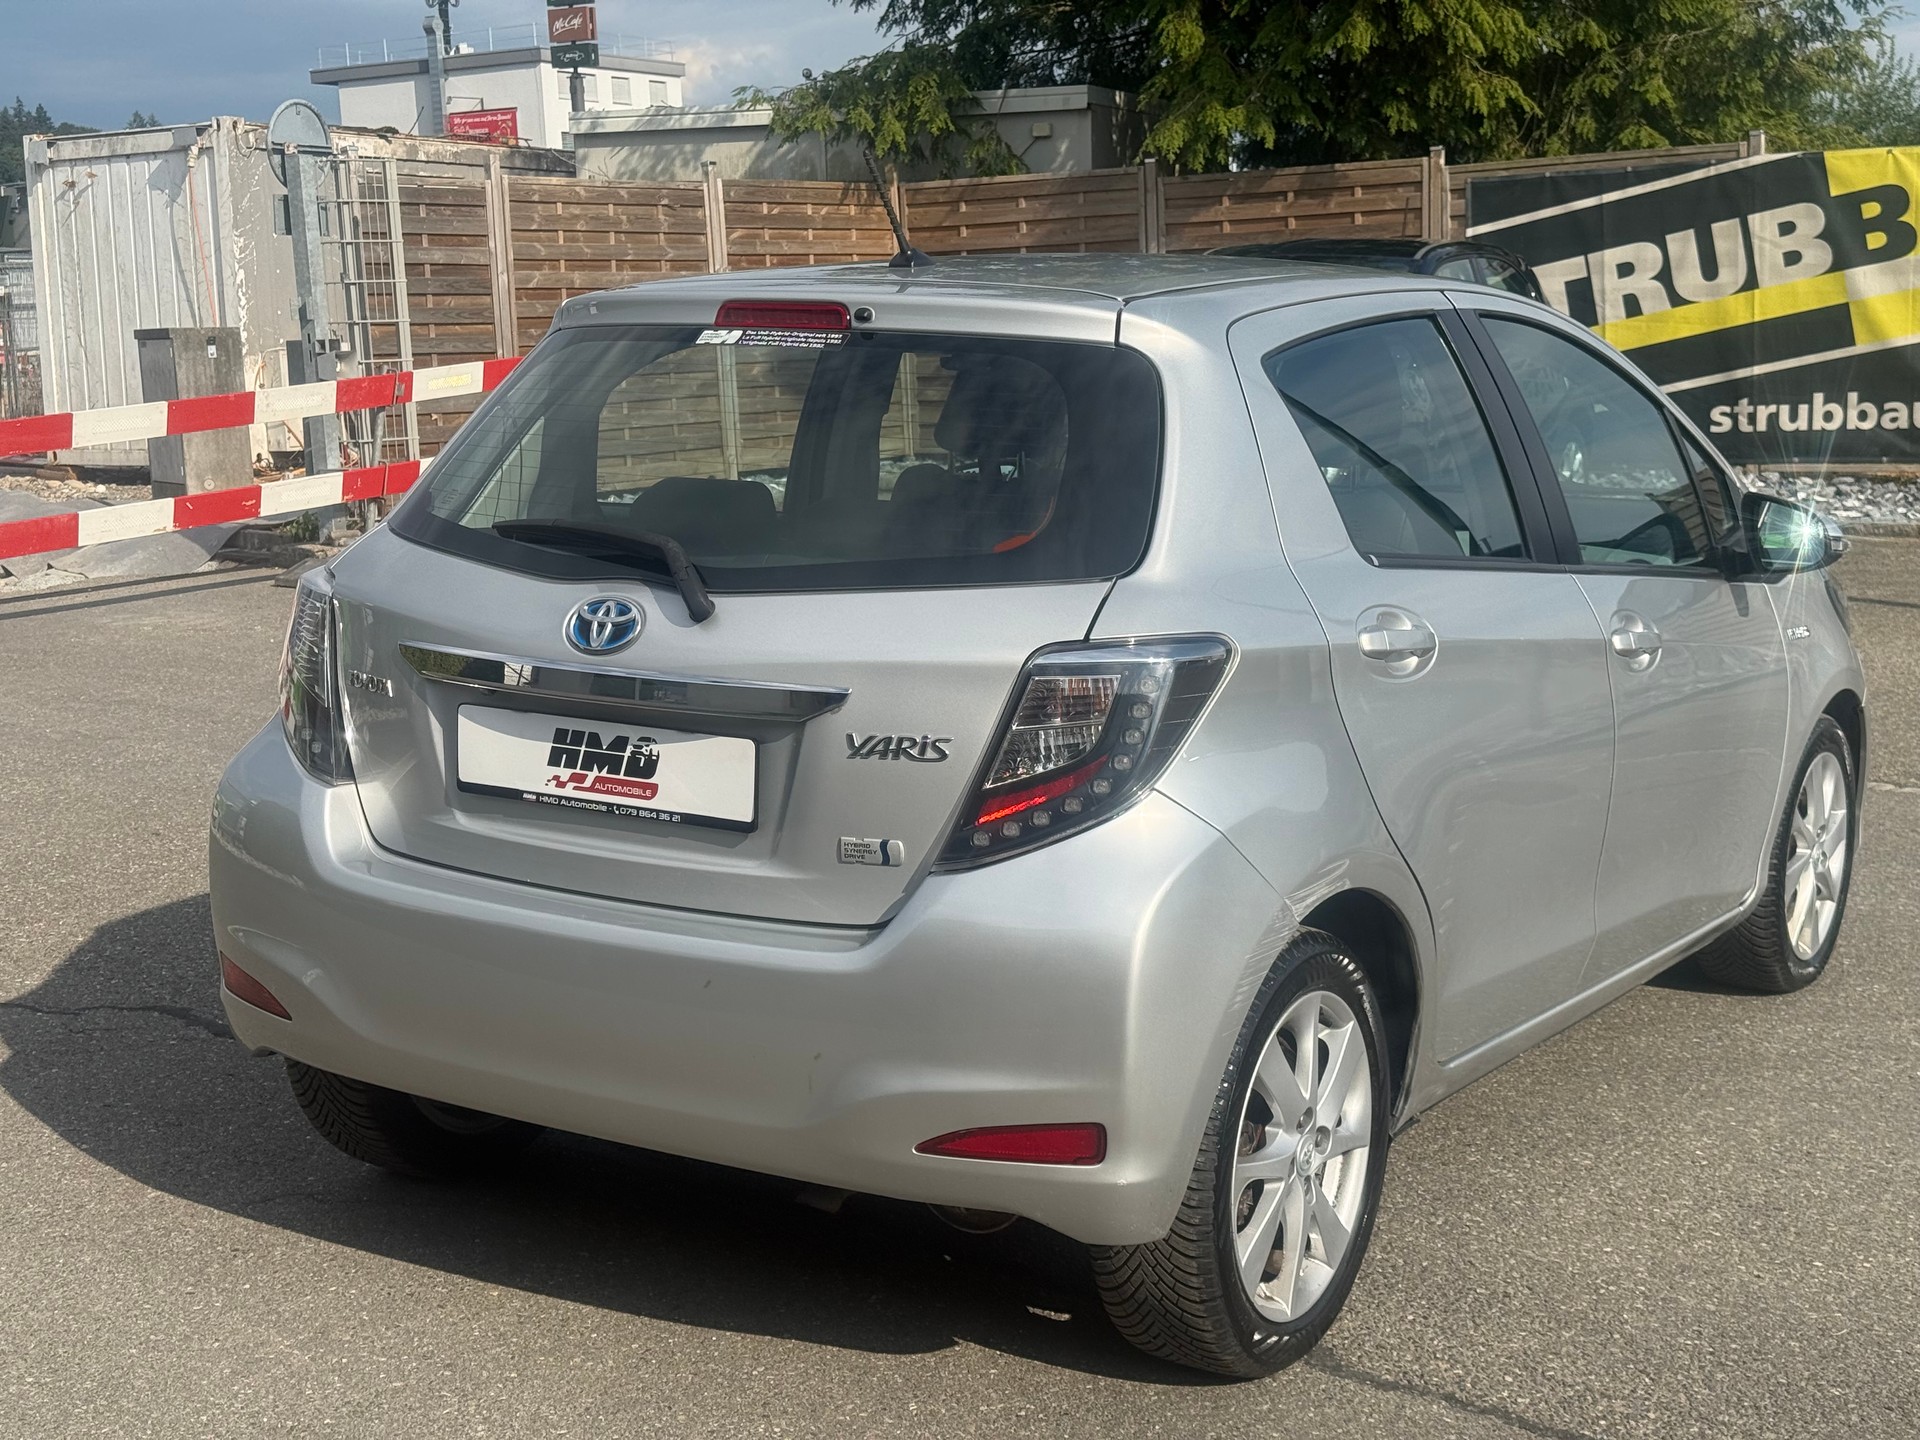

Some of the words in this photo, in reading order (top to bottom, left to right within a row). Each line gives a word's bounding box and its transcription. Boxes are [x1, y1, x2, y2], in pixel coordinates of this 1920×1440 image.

[594, 782, 652, 797] AUTOMOBILE
[560, 798, 608, 812] Automobile
[620, 807, 637, 816] 079
[639, 809, 657, 819] 864
[672, 814, 681, 823] 21
[844, 847, 878, 855] SYNERGY
